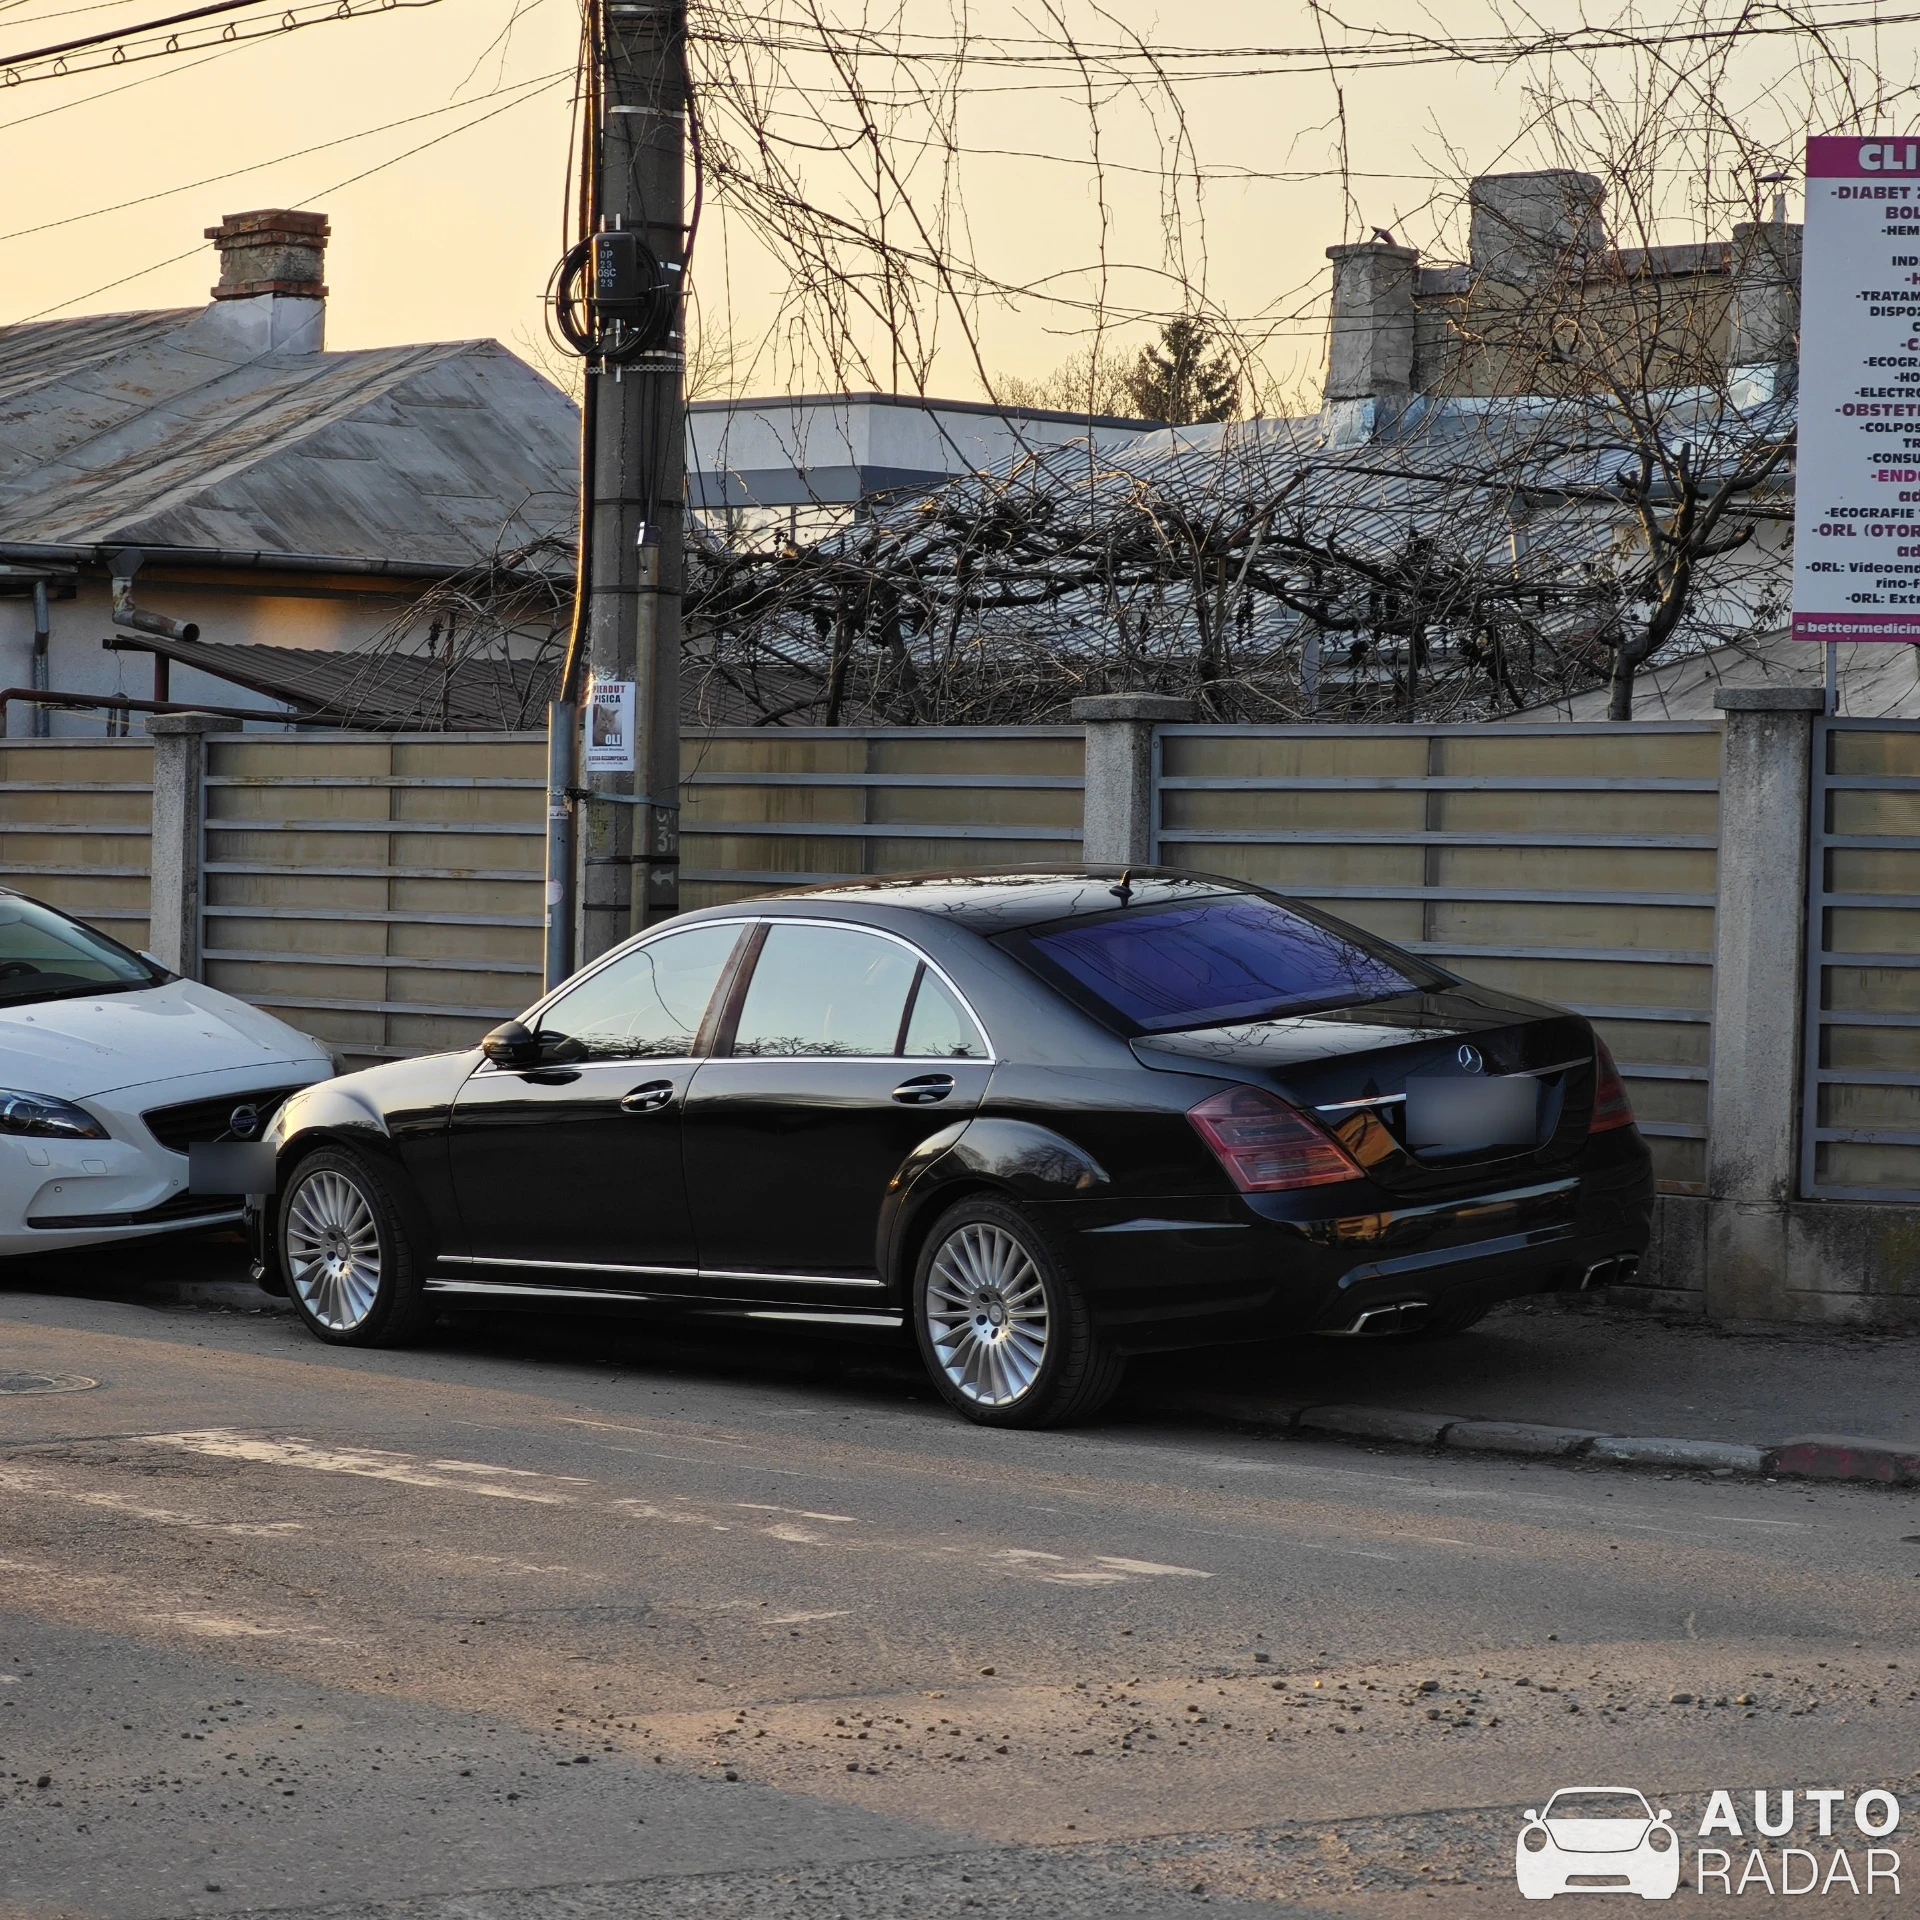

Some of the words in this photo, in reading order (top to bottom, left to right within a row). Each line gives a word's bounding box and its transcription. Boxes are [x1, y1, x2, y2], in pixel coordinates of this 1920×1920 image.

[1858, 144, 1917, 171] CLI
[1830, 186, 1911, 199] -DIABET
[1886, 206, 1920, 219] BOL
[1881, 225, 1920, 236] -HEM
[600, 250, 614, 259] DP
[600, 260, 612, 269] 23
[1891, 256, 1920, 266] IND
[600, 279, 613, 288] 23
[1856, 290, 1920, 301] -TRATAM
[1900, 337, 1920, 351] -C
[1863, 356, 1920, 367] -ECOGR
[1835, 403, 1920, 417] -OBSTET
[1860, 422, 1920, 433] -COLPOS
[1871, 469, 1920, 482] -END
[1825, 507, 1915, 518] -ECOGRAFIE
[1811, 523, 1857, 536] -ORL
[1864, 524, 1920, 538] (OTOR
[1805, 562, 1845, 573] -ORL:
[1845, 592, 1885, 604] -ORL:
[592, 685, 626, 694] PIERDUT
[594, 694, 621, 704] PISICA
[605, 733, 621, 745] OLI
